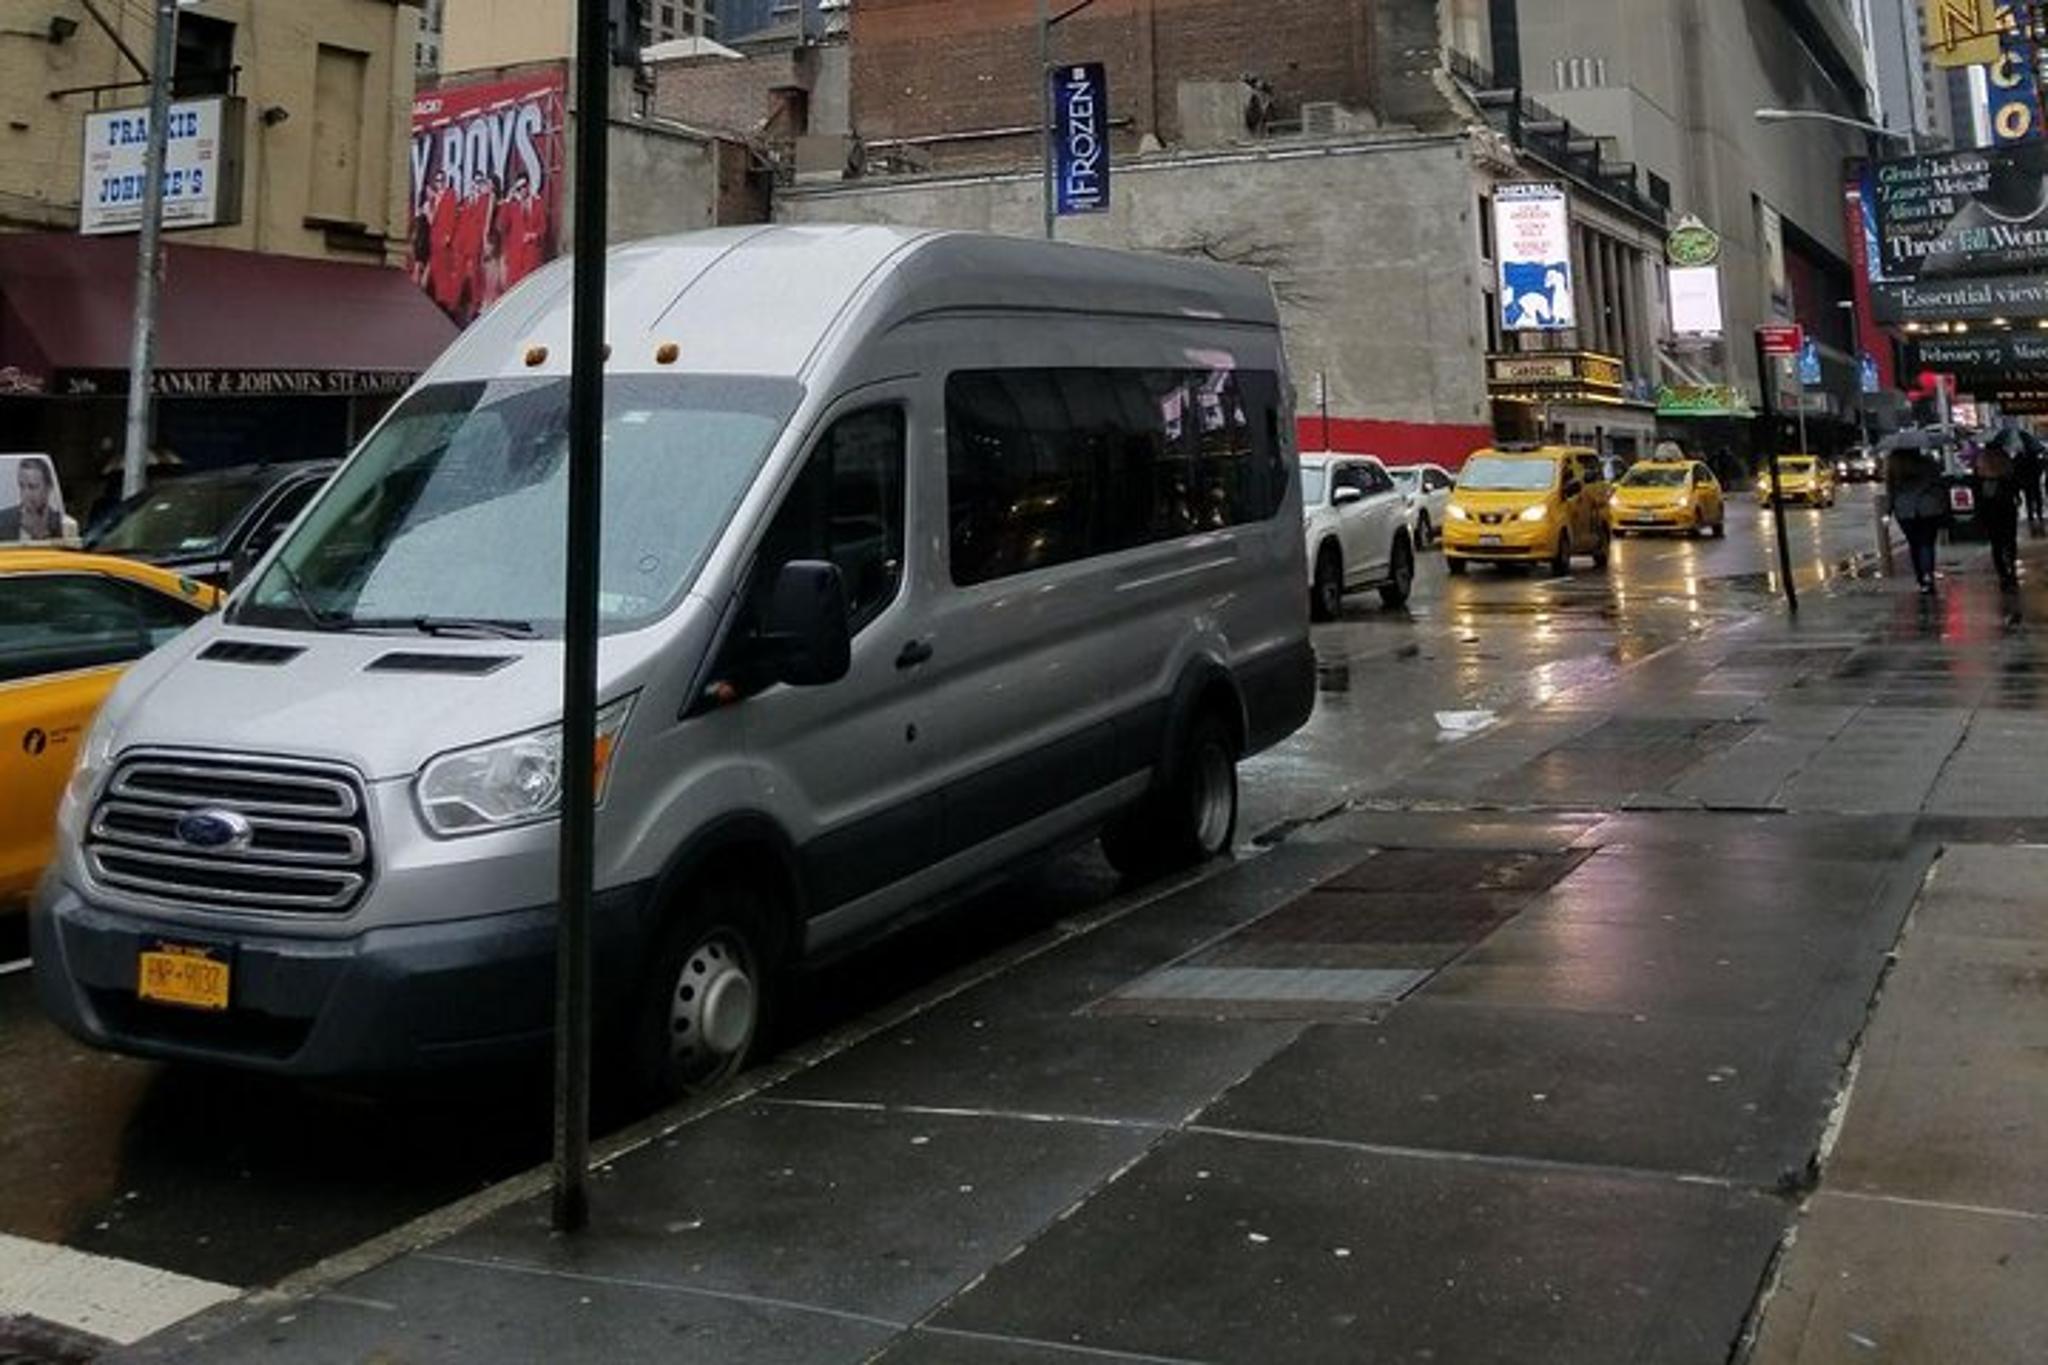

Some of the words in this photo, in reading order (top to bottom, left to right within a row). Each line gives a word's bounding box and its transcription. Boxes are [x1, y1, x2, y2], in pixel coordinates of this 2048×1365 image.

[109, 112, 198, 146] FRAKIE
[1066, 81, 1101, 204] FROZEN
[443, 101, 542, 201] BOYS
[1931, 159, 1990, 177] Jackson
[1886, 234, 1952, 257] Three
[1960, 227, 1989, 251] Tall
[1919, 347, 1981, 365] February
